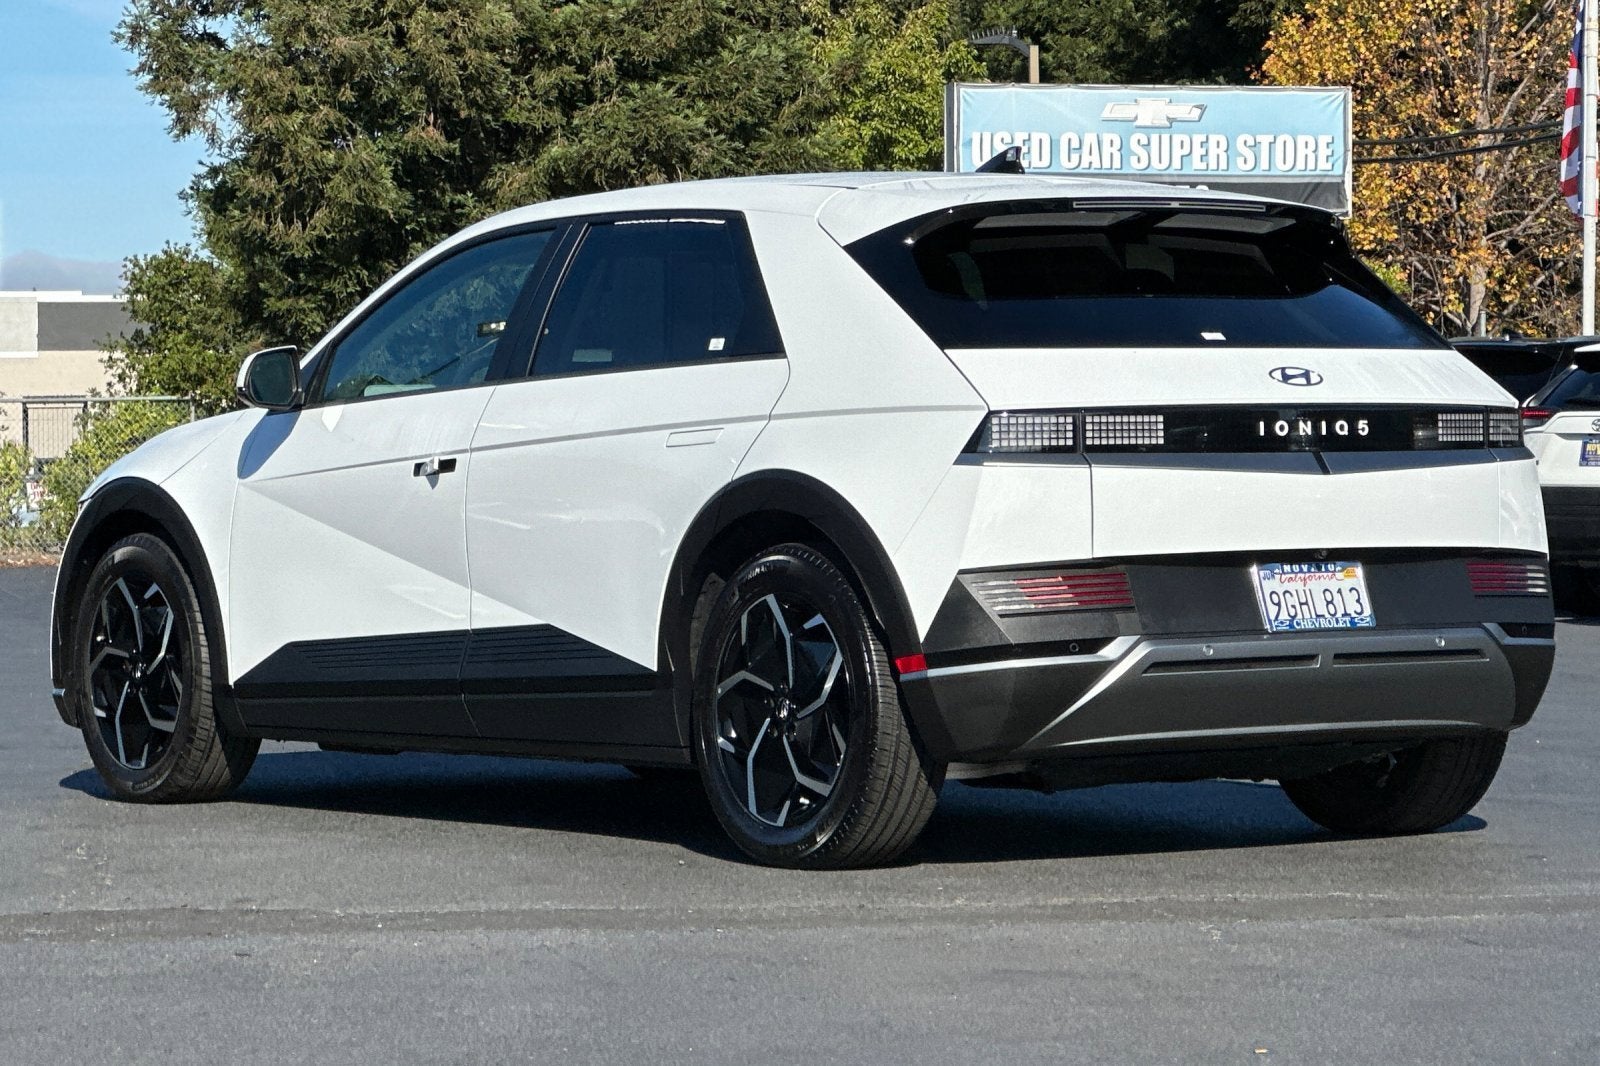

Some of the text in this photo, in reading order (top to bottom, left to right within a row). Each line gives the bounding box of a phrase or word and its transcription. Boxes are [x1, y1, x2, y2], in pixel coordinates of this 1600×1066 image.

[971, 131, 1334, 172] USED CAR SUPER STORE
[1279, 571, 1344, 587] California
[1293, 617, 1351, 629] CHEVROLET
